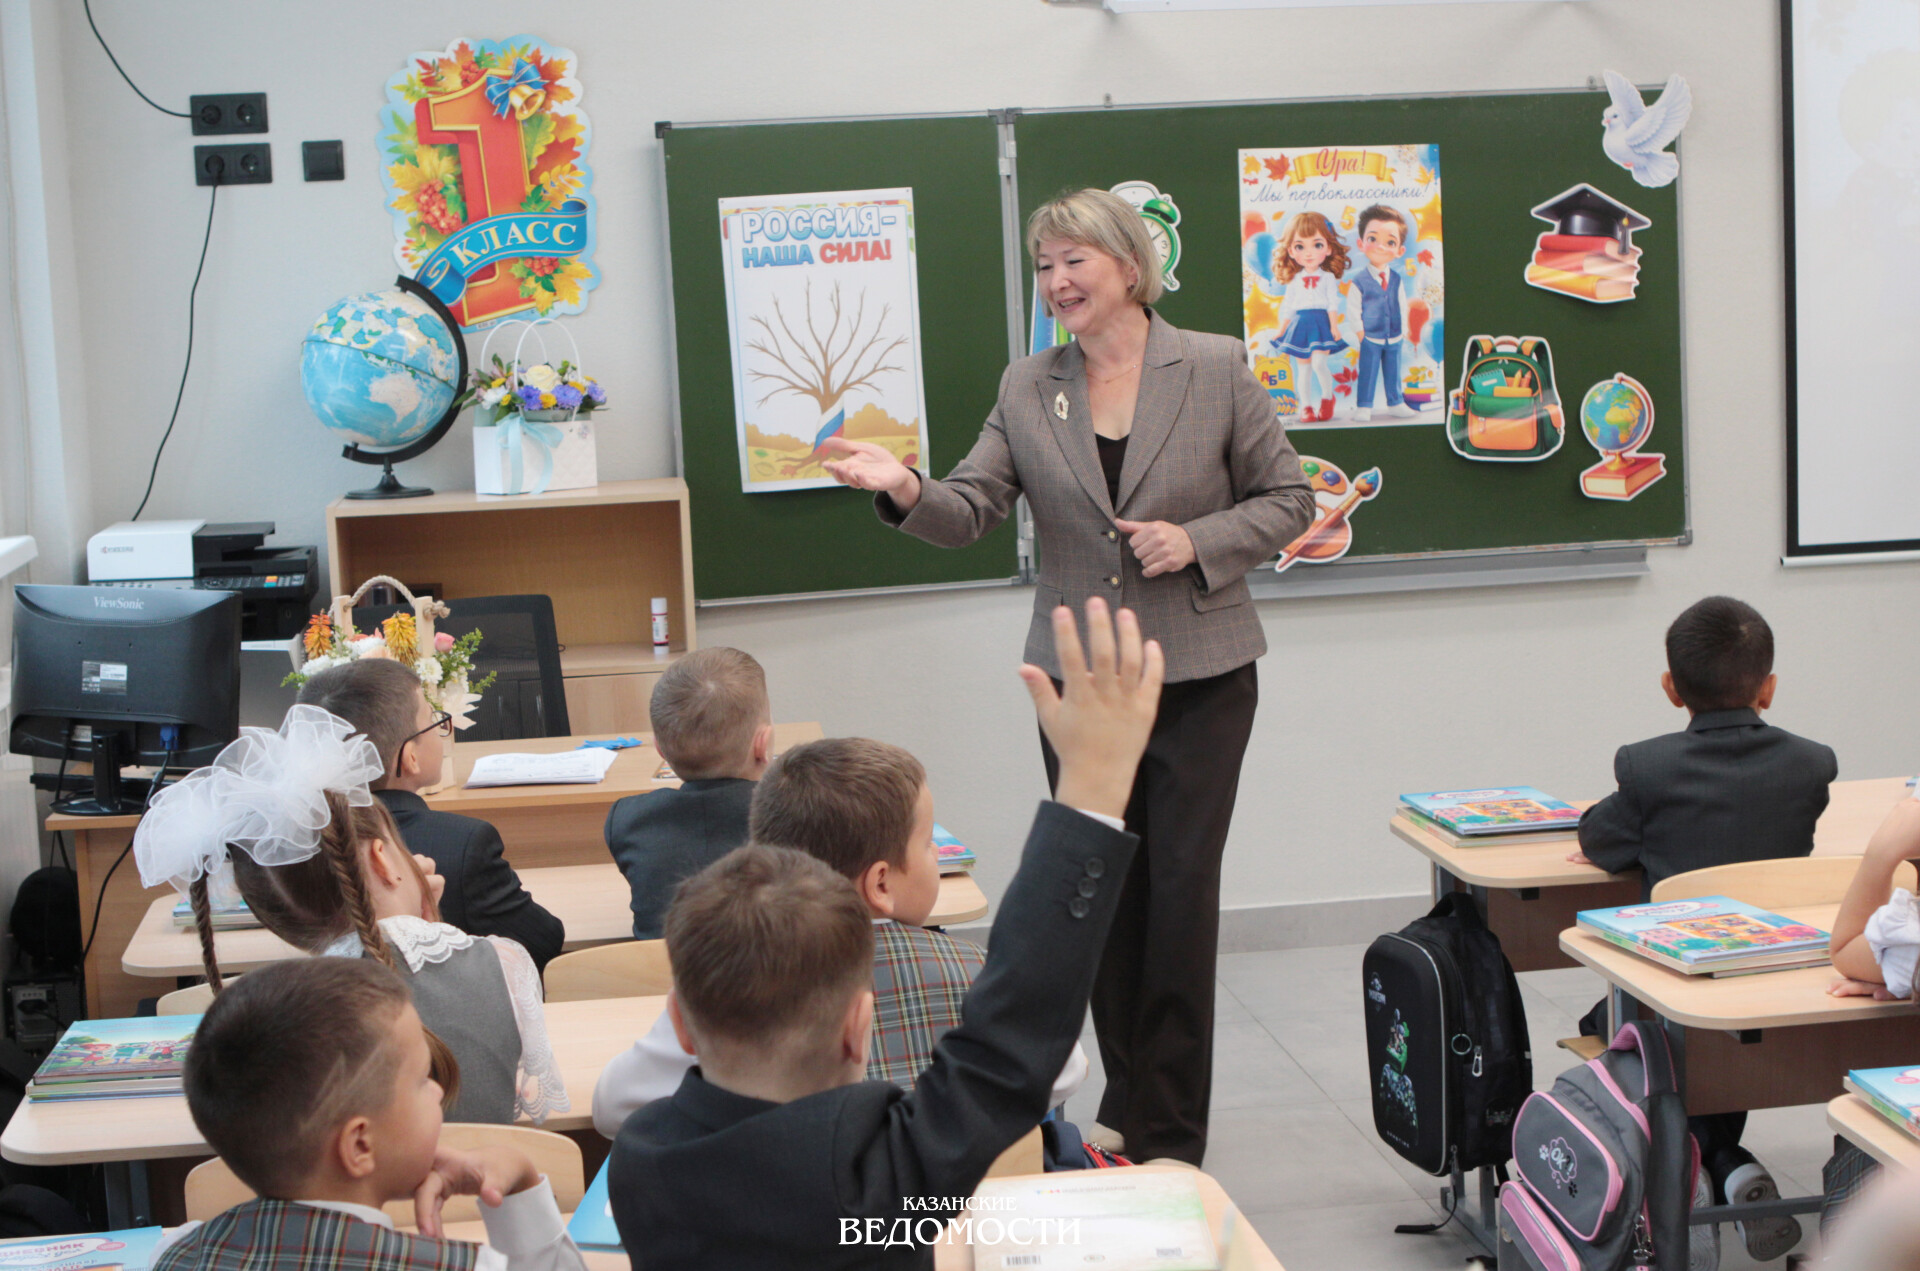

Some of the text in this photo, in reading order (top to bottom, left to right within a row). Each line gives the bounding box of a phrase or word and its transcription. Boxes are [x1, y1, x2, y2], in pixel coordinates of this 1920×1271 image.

[1316, 148, 1367, 182] Ура!
[414, 67, 561, 327] 1
[1249, 182, 1431, 208] Мы первоклассники!
[742, 206, 896, 243] РОССИЯ-
[1340, 205, 1357, 230] 5
[449, 221, 578, 268] КЛАСС
[742, 238, 892, 268] НАША СИЛА!
[1161, 240, 1168, 249] 3
[1405, 258, 1417, 277] 5
[1261, 369, 1287, 386] АБВ
[93, 596, 145, 610] ViewSonic
